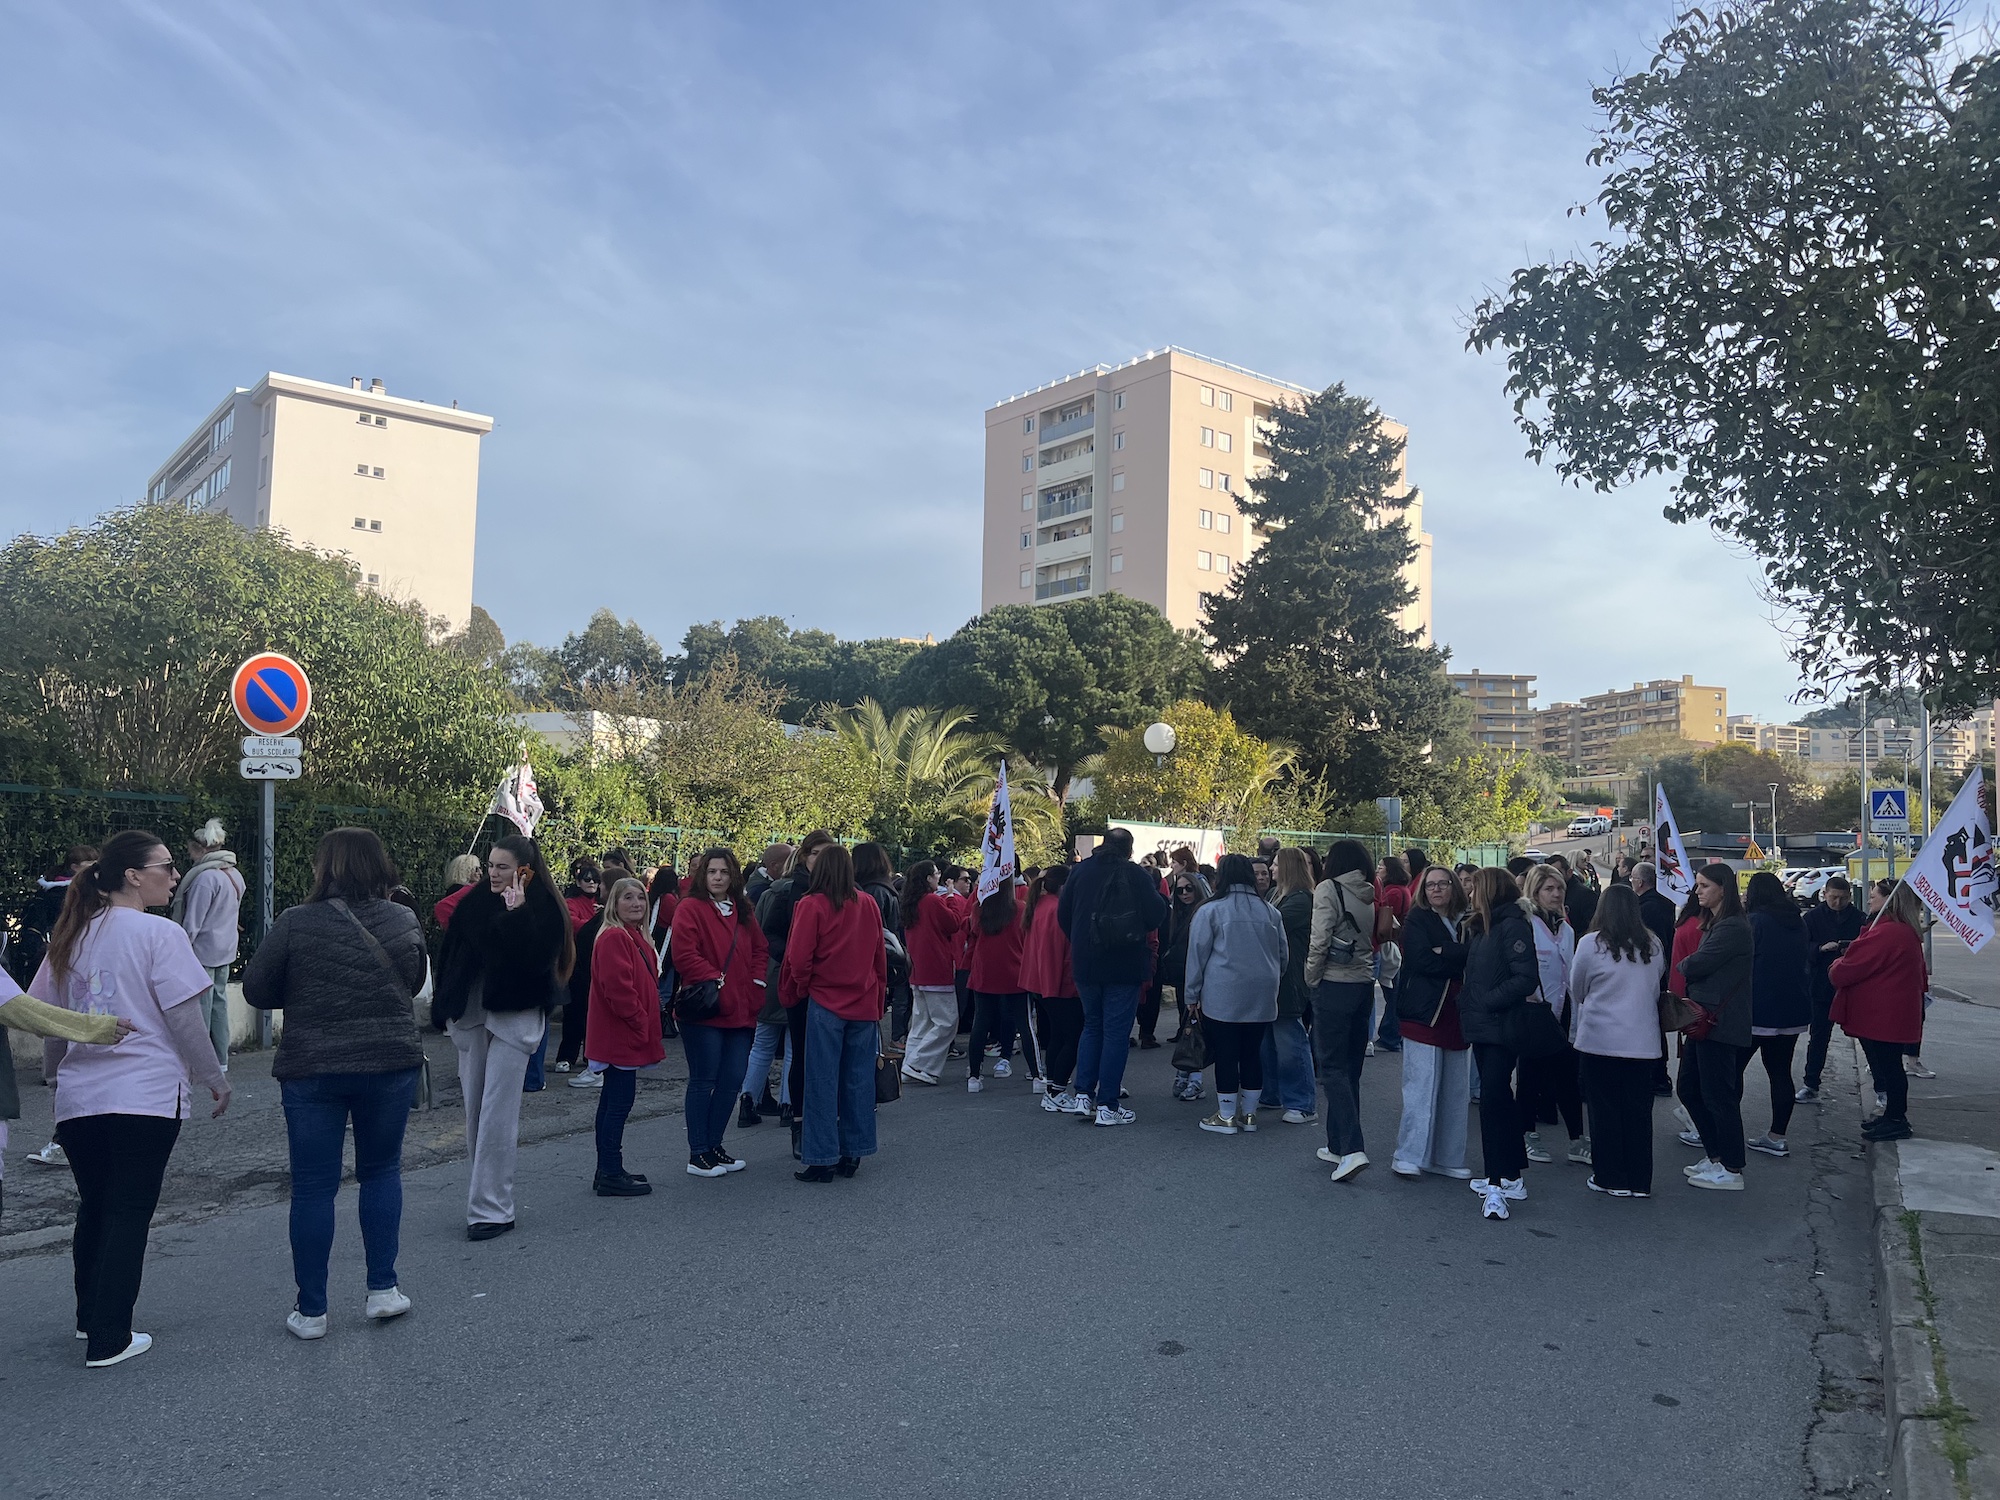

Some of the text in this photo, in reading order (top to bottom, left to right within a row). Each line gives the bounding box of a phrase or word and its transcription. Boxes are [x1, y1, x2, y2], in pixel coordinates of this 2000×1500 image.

[267, 748, 295, 756] SCOLAIRE
[1913, 871, 1984, 947] LIBERAZIONE NAZIUNALE
